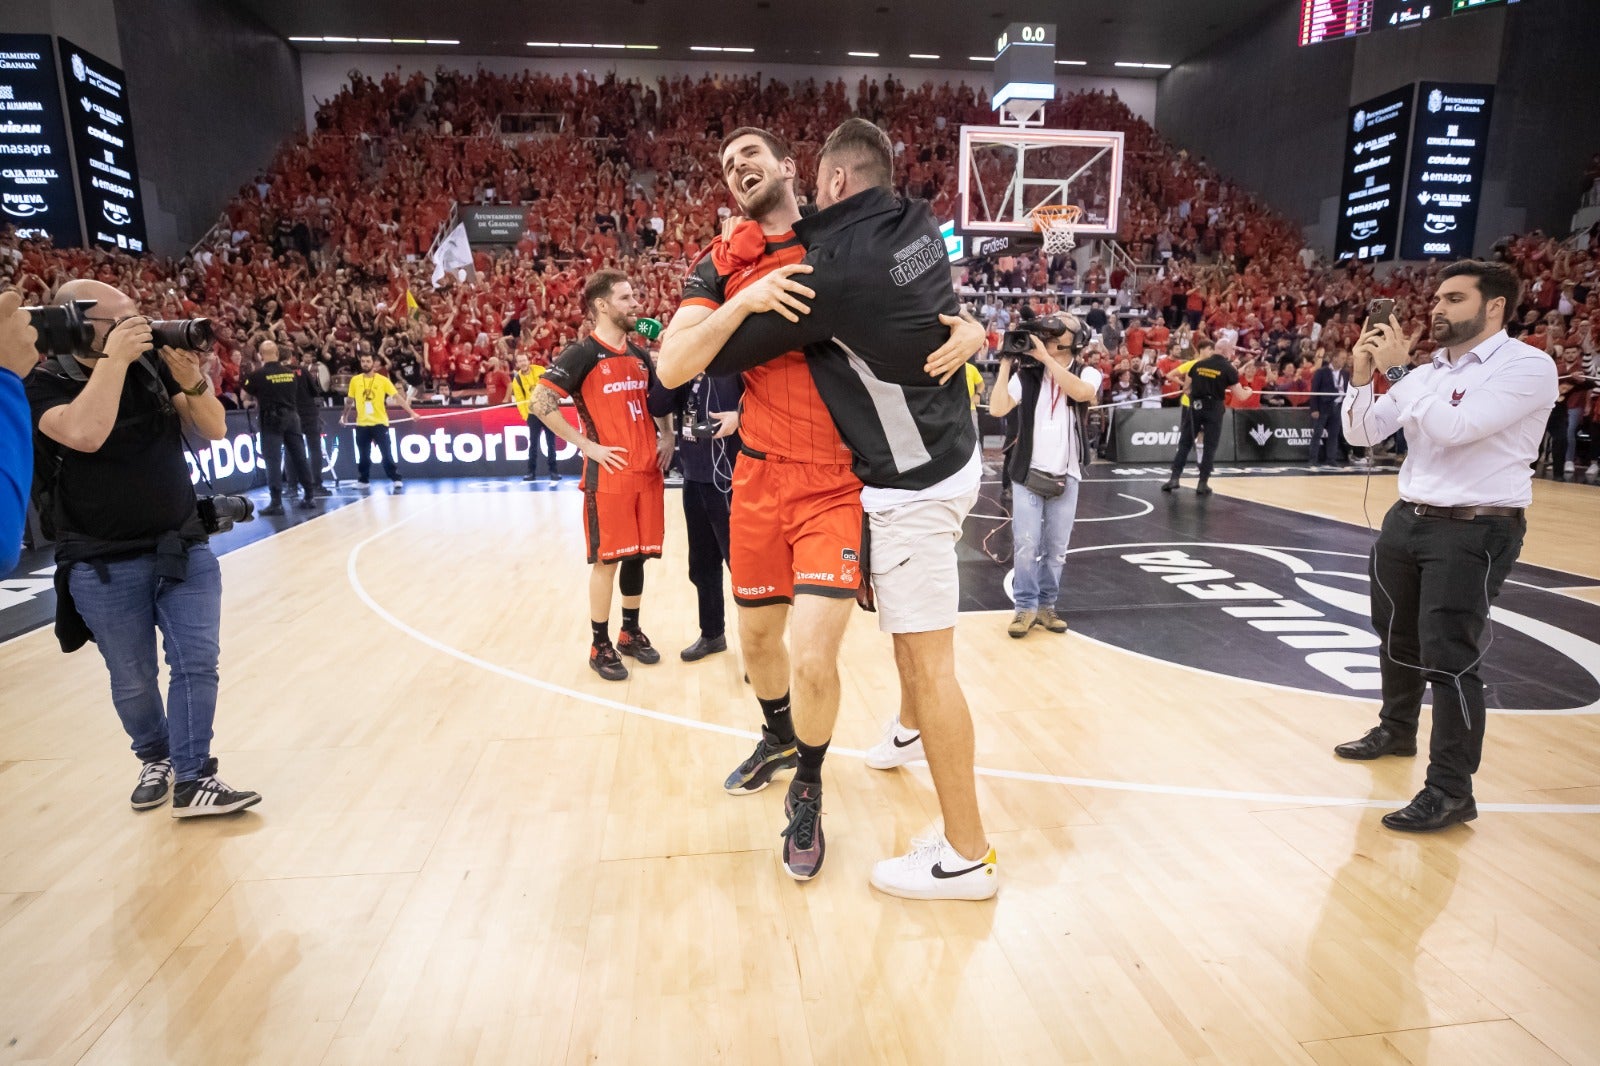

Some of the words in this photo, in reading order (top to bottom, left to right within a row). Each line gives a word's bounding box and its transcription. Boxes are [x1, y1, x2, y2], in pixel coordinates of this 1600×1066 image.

[1022, 26, 1045, 42] 0.0
[1429, 172, 1472, 184] emasagra
[3, 193, 44, 203] PULEVA
[1426, 213, 1455, 223] PULEVA
[983, 237, 1008, 255] endesa
[627, 399, 644, 422] 14
[1274, 428, 1299, 438] CAJA
